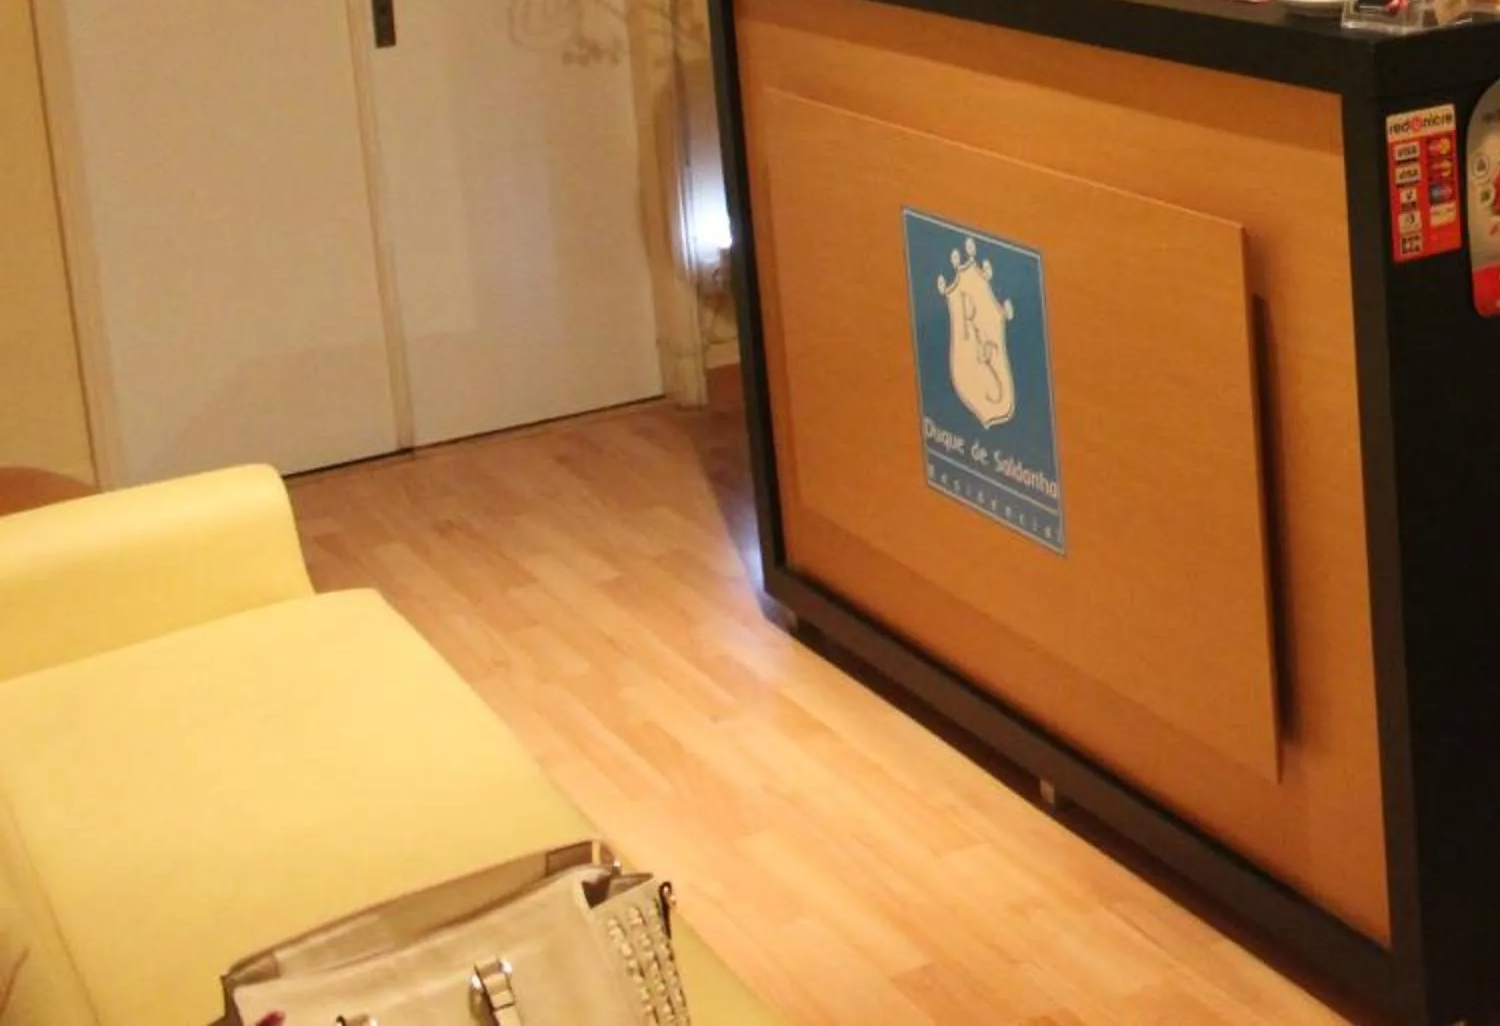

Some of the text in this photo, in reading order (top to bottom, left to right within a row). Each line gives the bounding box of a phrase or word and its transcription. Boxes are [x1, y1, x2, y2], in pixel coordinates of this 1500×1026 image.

[924, 417, 1057, 499] Duque de Saldanha
